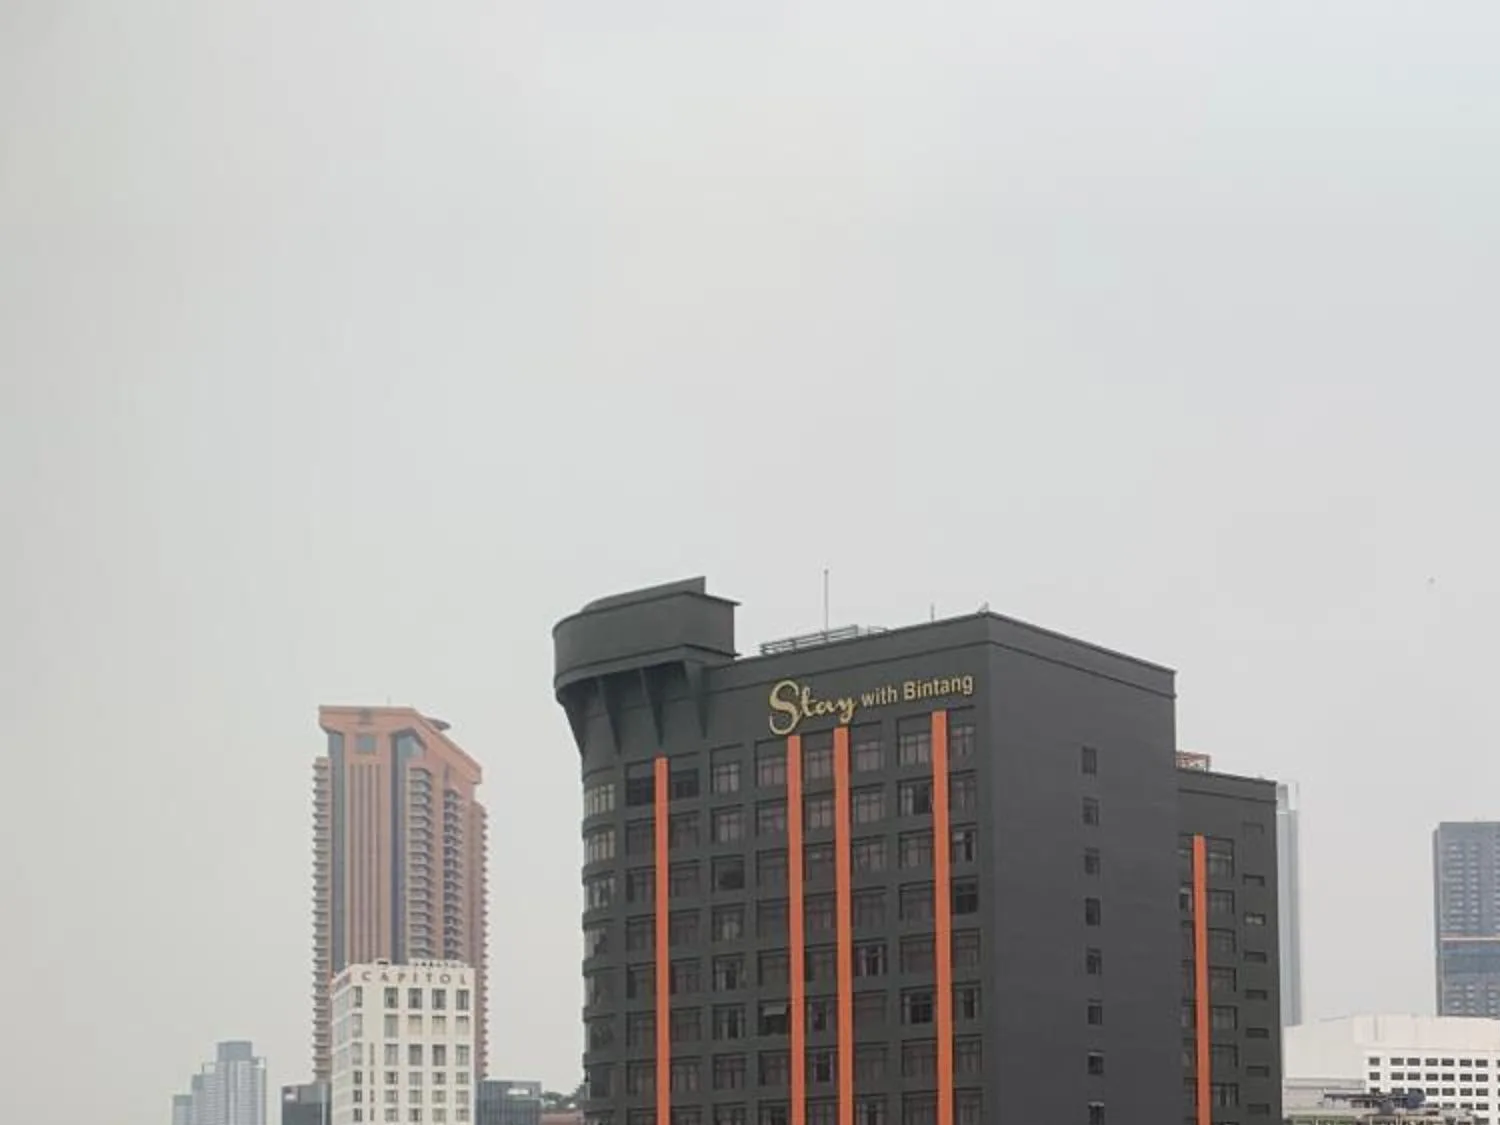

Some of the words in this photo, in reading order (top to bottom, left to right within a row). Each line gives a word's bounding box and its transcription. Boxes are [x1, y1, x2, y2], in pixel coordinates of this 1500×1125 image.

[768, 678, 856, 735] Stay
[861, 686, 897, 708] with
[903, 674, 974, 701] Bintang
[361, 971, 467, 985] CAPITOL
